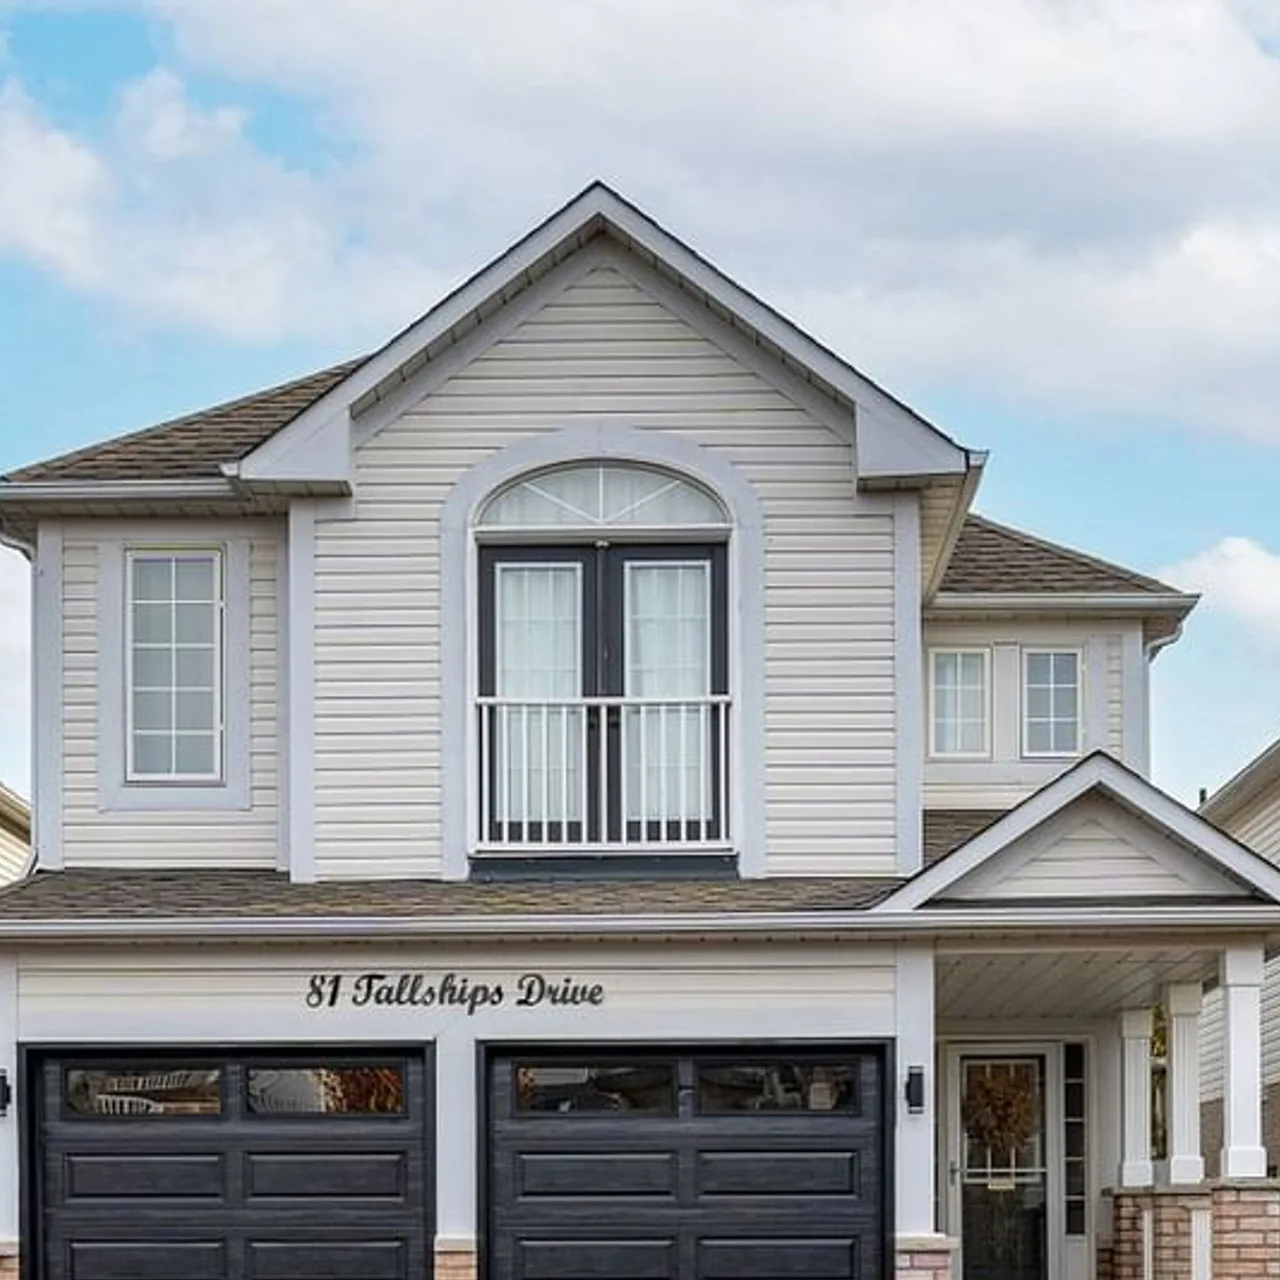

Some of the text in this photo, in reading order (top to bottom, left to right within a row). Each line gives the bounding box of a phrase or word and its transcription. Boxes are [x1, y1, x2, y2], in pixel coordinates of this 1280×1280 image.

[306, 973, 604, 1016] 81 Tallships Drive
